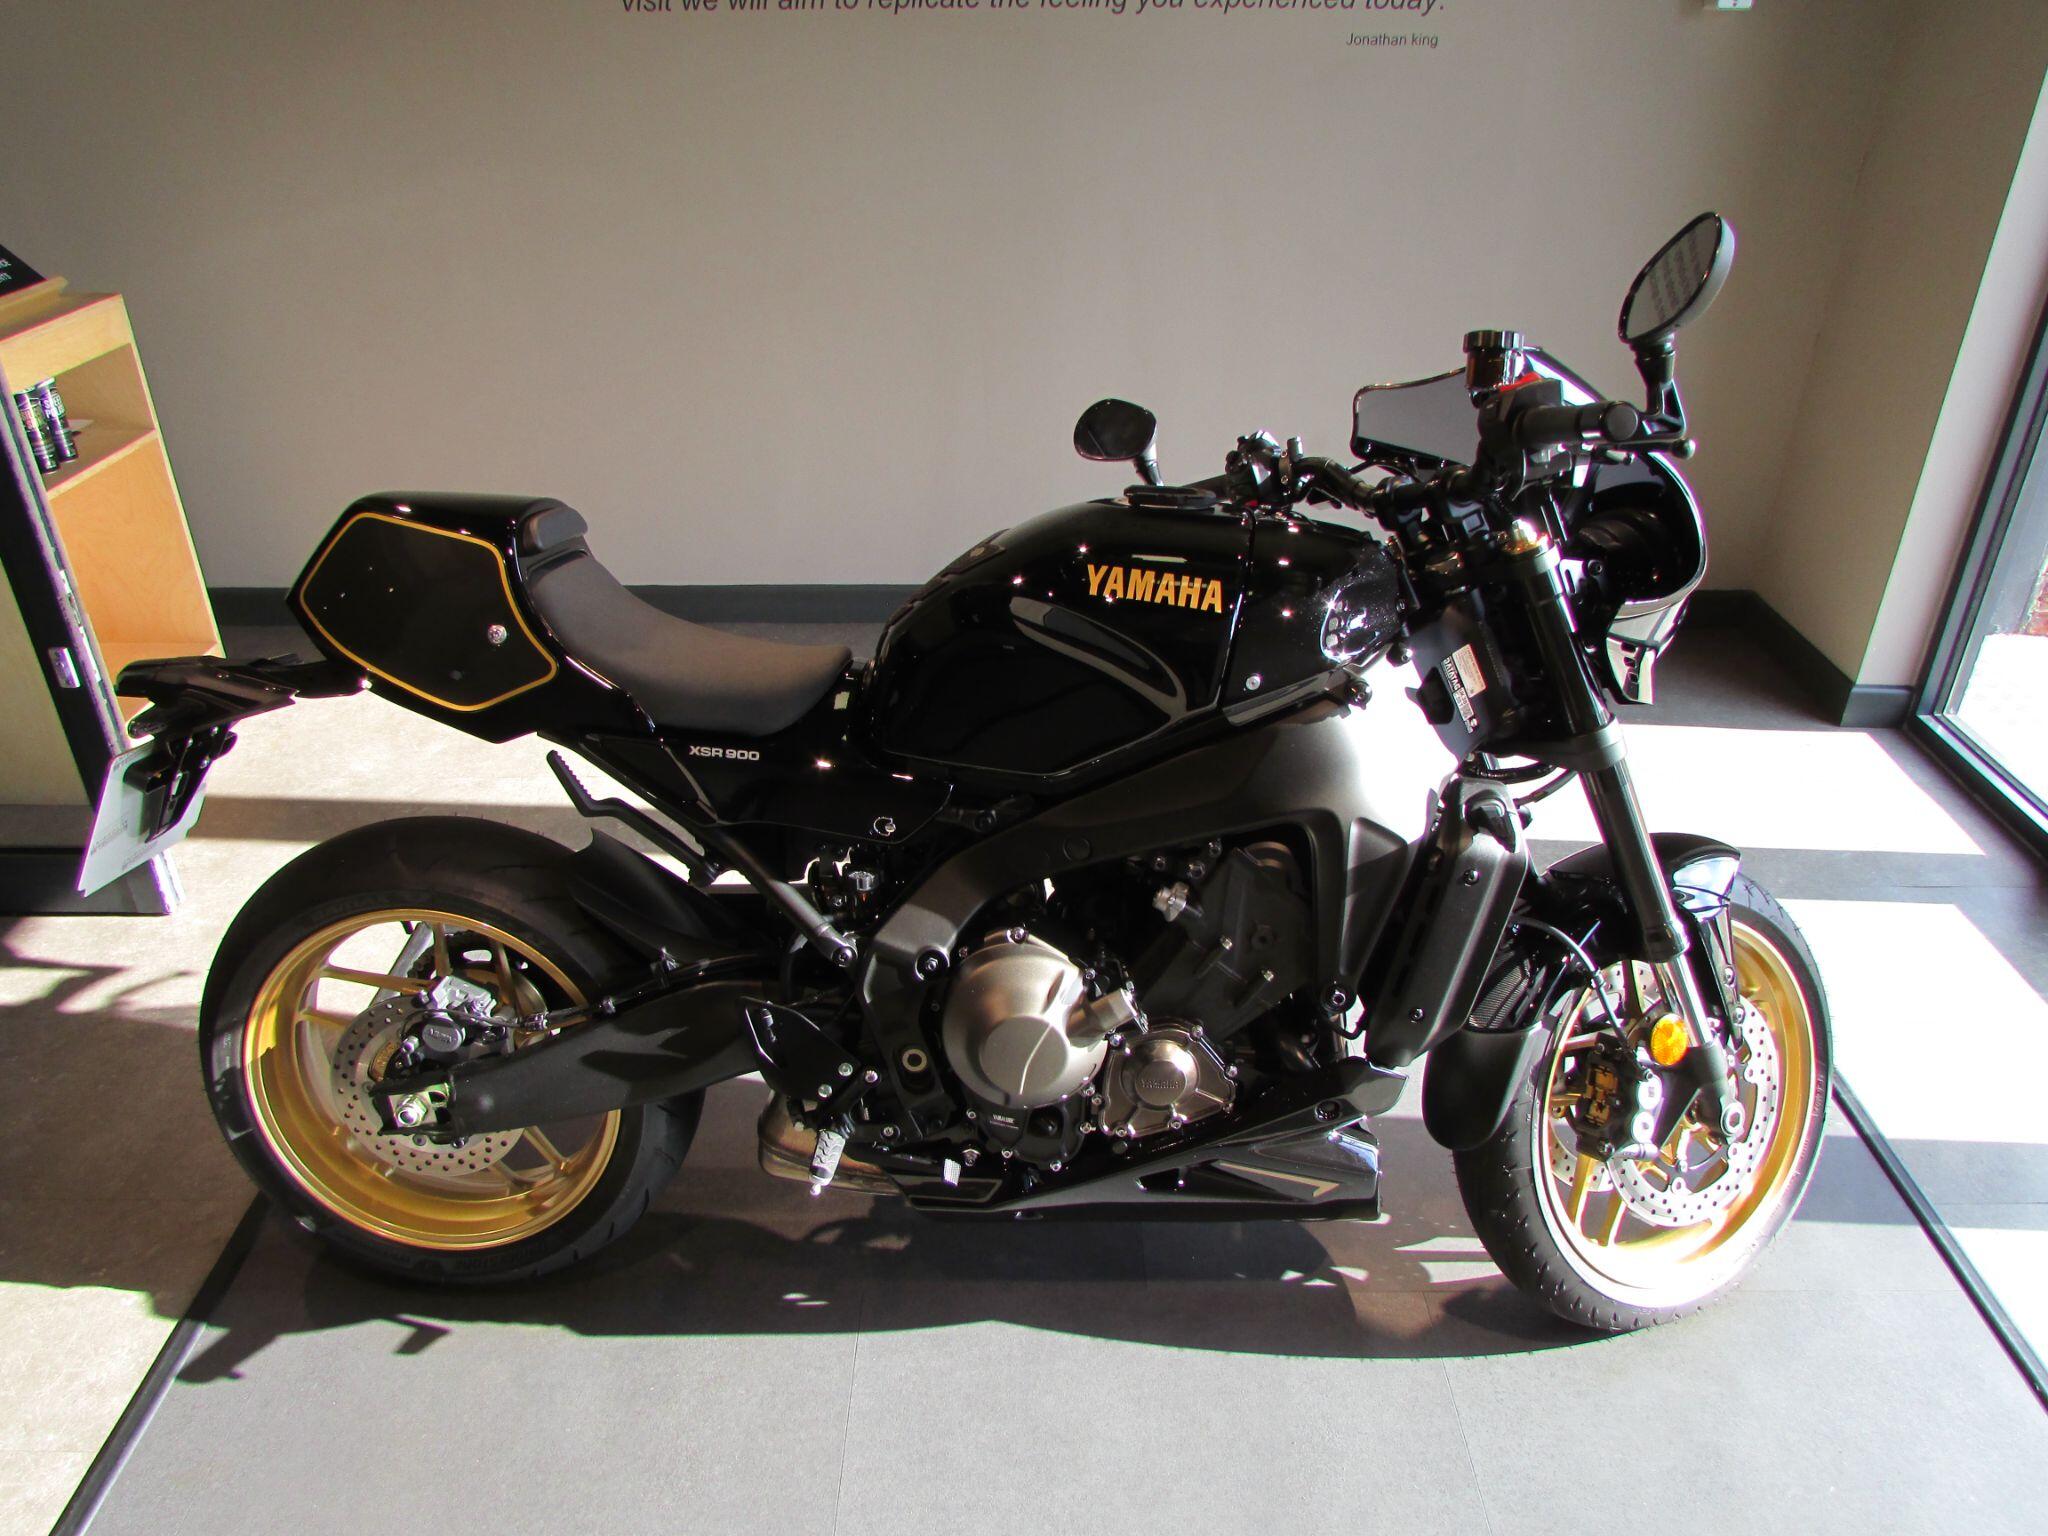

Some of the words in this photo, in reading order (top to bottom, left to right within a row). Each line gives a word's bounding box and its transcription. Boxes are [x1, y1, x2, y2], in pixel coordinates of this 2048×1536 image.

[1346, 32, 1407, 46] Jonathan
[1411, 33, 1439, 49] king
[1087, 564, 1222, 614] YAMAHA
[689, 745, 723, 758] XSR
[725, 748, 760, 761] 900
